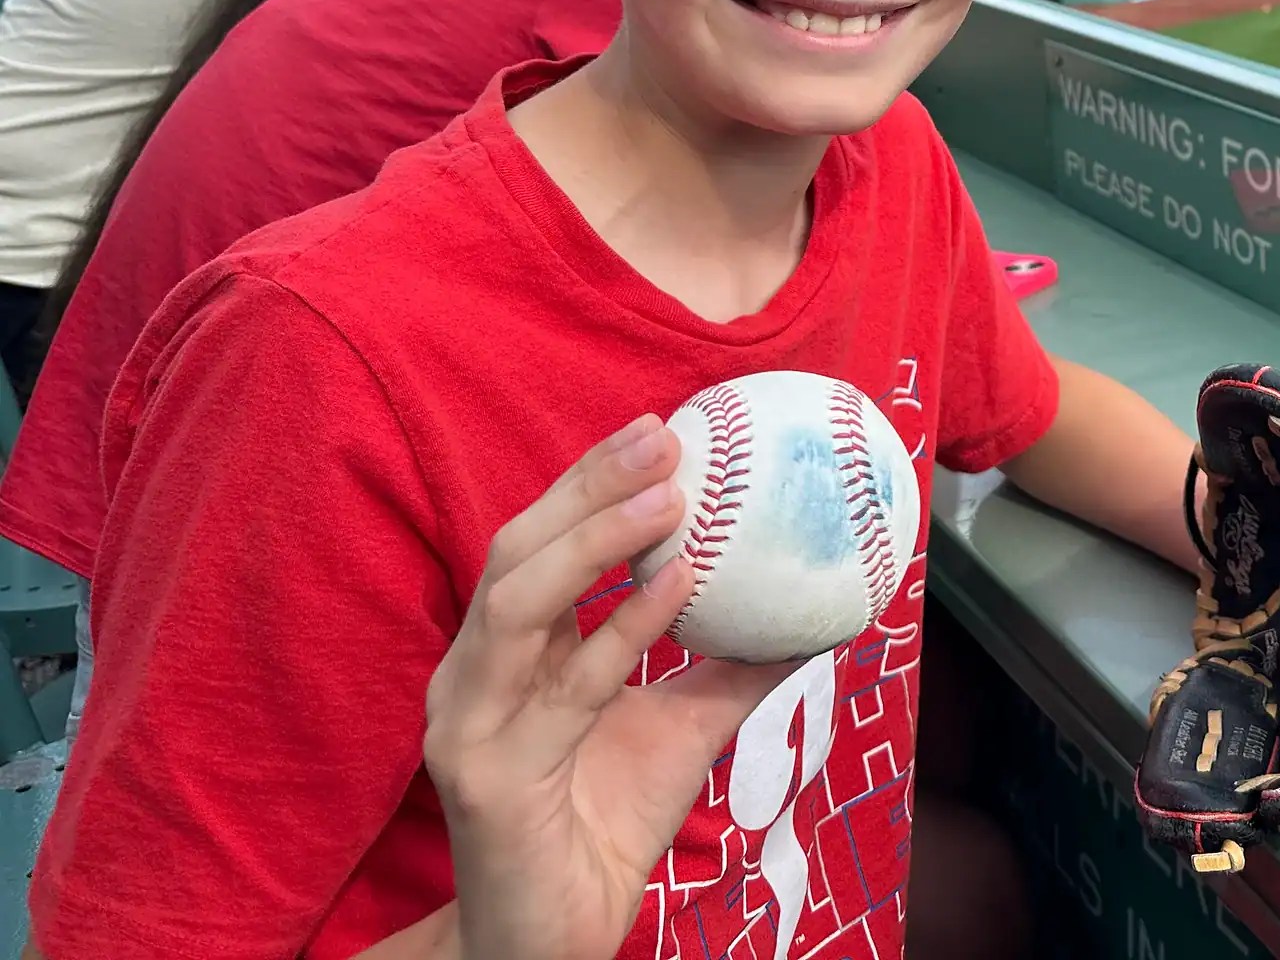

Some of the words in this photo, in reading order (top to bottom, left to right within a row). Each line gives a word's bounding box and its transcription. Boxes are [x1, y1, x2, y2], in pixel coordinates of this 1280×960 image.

[1058, 74, 1206, 169] WARNING:
[1064, 149, 1155, 218] PLEASE
[1163, 195, 1201, 239] DO
[1213, 217, 1272, 274] NOT
